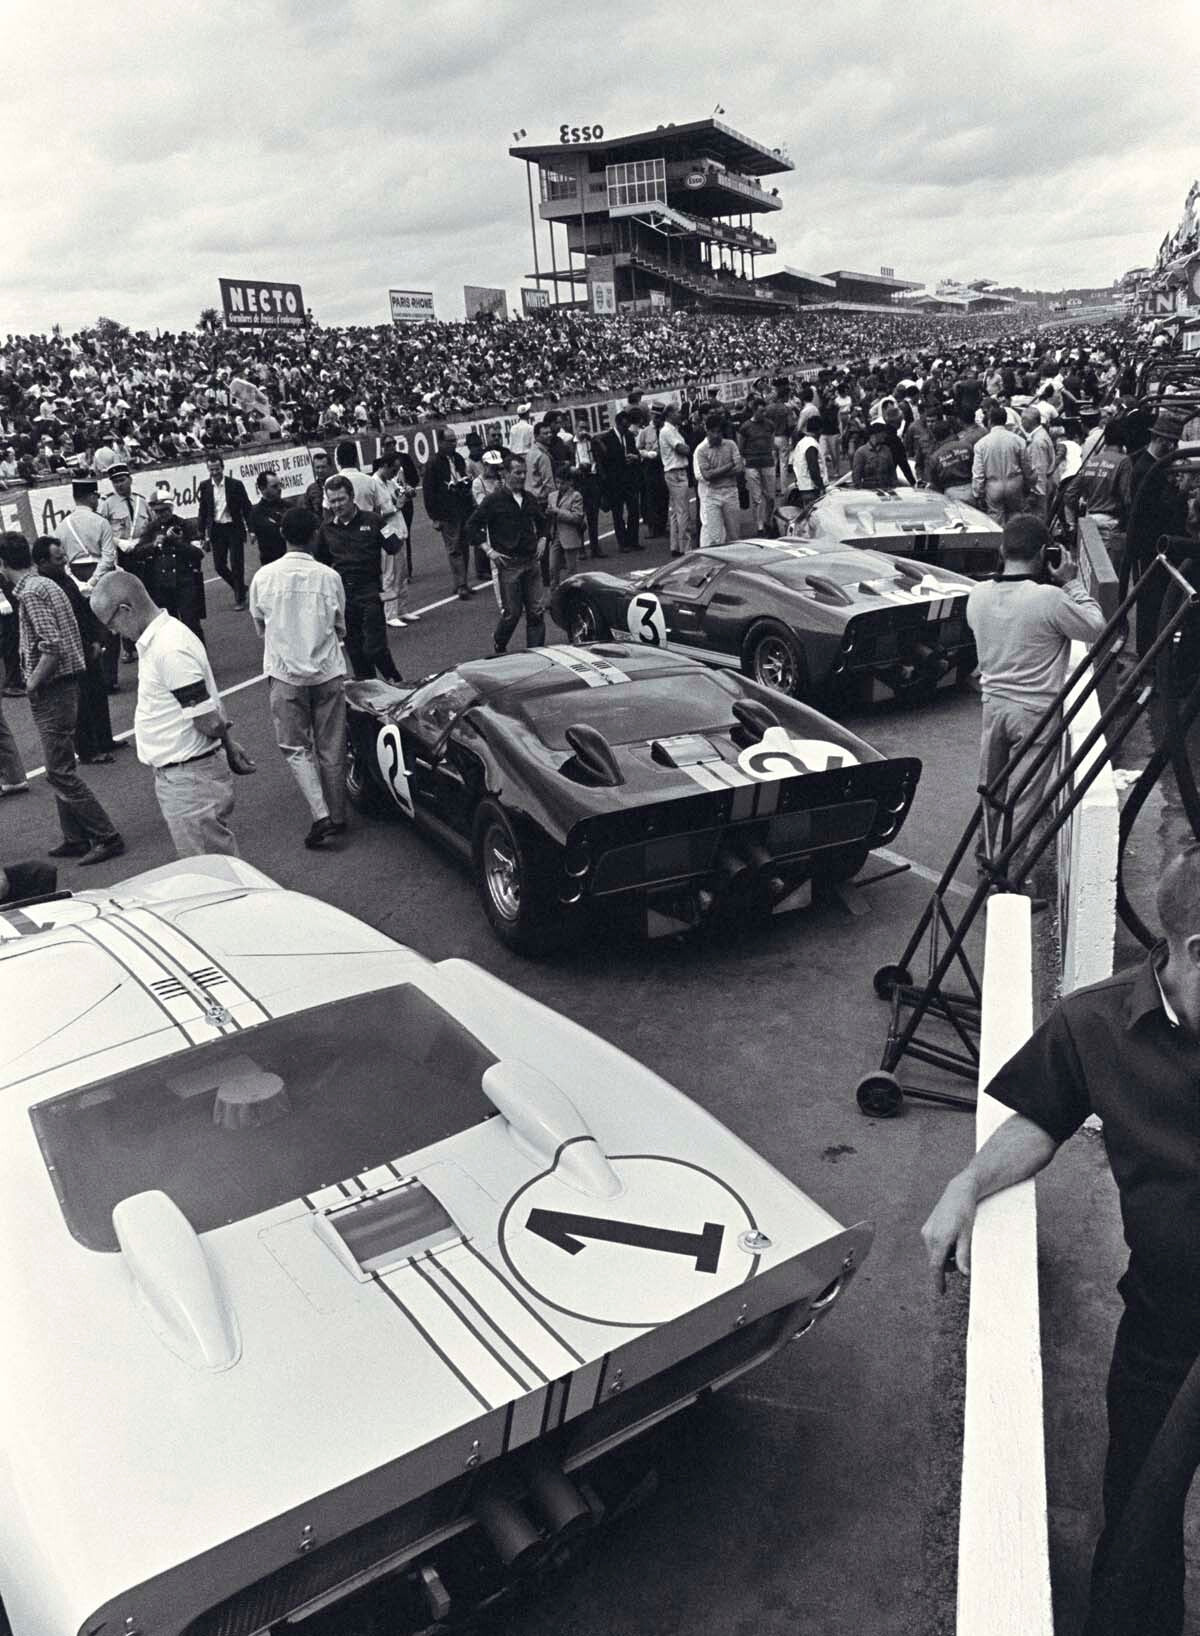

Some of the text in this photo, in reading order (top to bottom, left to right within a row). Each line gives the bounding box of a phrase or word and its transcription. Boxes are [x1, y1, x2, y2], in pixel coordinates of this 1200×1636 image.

[229, 287, 297, 313] NECTO
[282, 457, 291, 471] DE
[636, 597, 660, 646] 3
[383, 732, 412, 811] 2
[525, 1207, 725, 1275] 1
